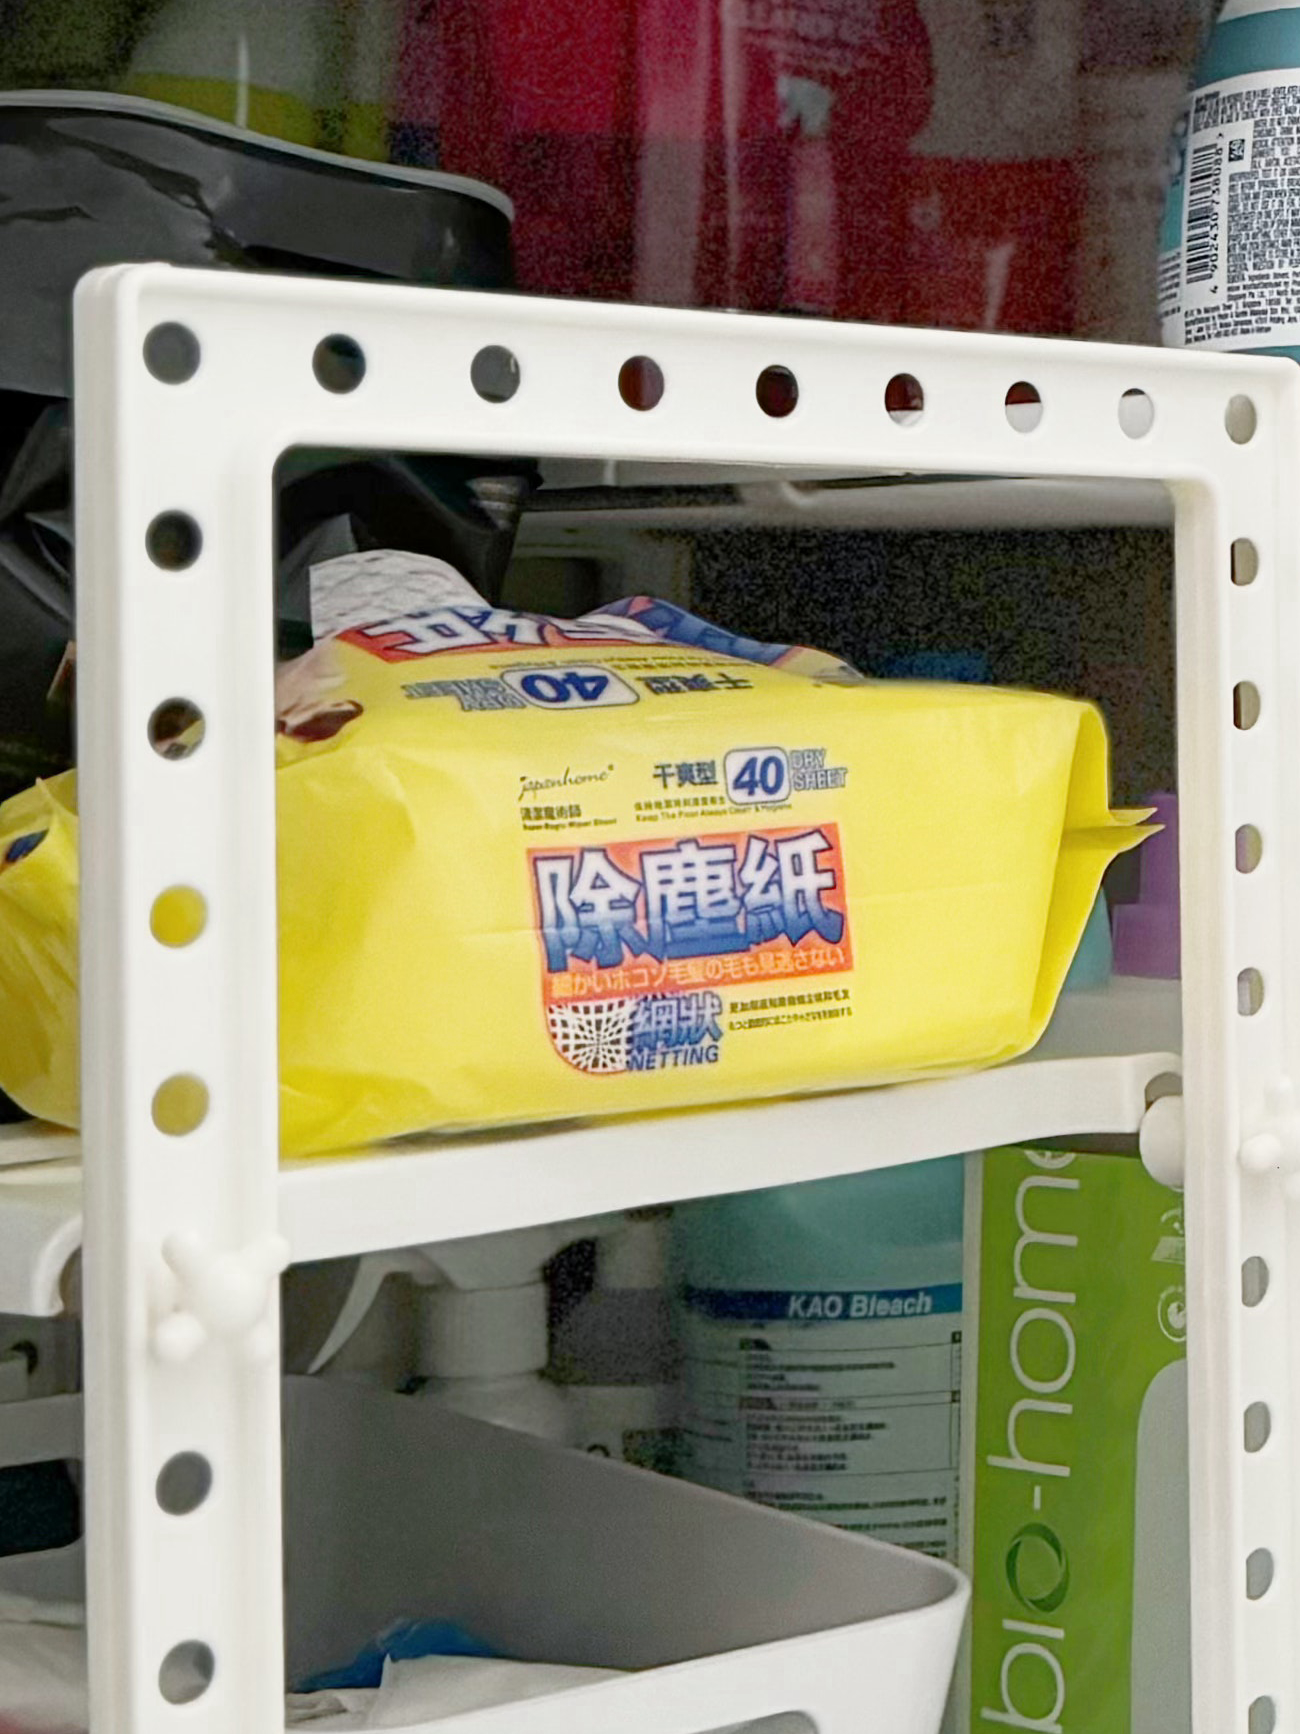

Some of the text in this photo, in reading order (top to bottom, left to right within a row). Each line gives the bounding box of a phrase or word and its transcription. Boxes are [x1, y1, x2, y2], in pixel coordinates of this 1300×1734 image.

[1209, 212, 1220, 274] 902430
[521, 670, 610, 704] 40
[790, 747, 827, 770] DRY
[733, 755, 785, 797] 40
[792, 767, 848, 792] SHEET
[636, 813, 659, 823] Keep
[661, 811, 676, 820] The
[700, 808, 727, 817] Always
[532, 828, 846, 974] 除塵紙
[629, 1044, 720, 1073] NETTING
[787, 1292, 934, 1319] KAO Bleach
